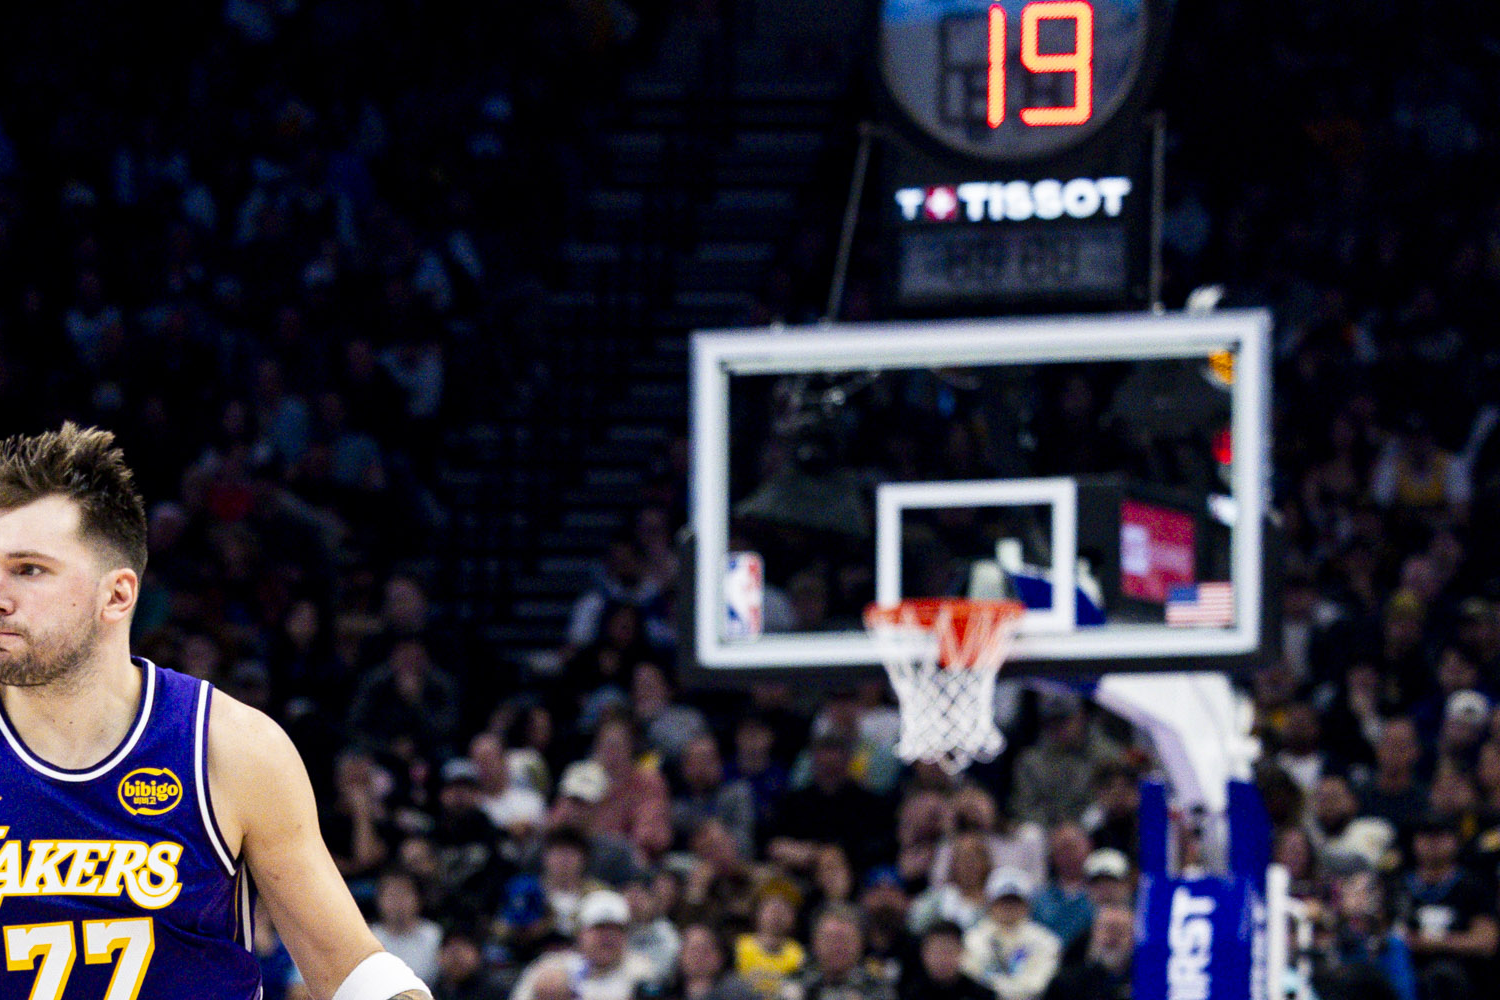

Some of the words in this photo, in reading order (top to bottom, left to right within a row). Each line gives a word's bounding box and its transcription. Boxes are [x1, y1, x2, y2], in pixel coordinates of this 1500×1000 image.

[987, 0, 1094, 129] 19
[957, 177, 1132, 222] TISSOT
[124, 780, 178, 802] bibigo
